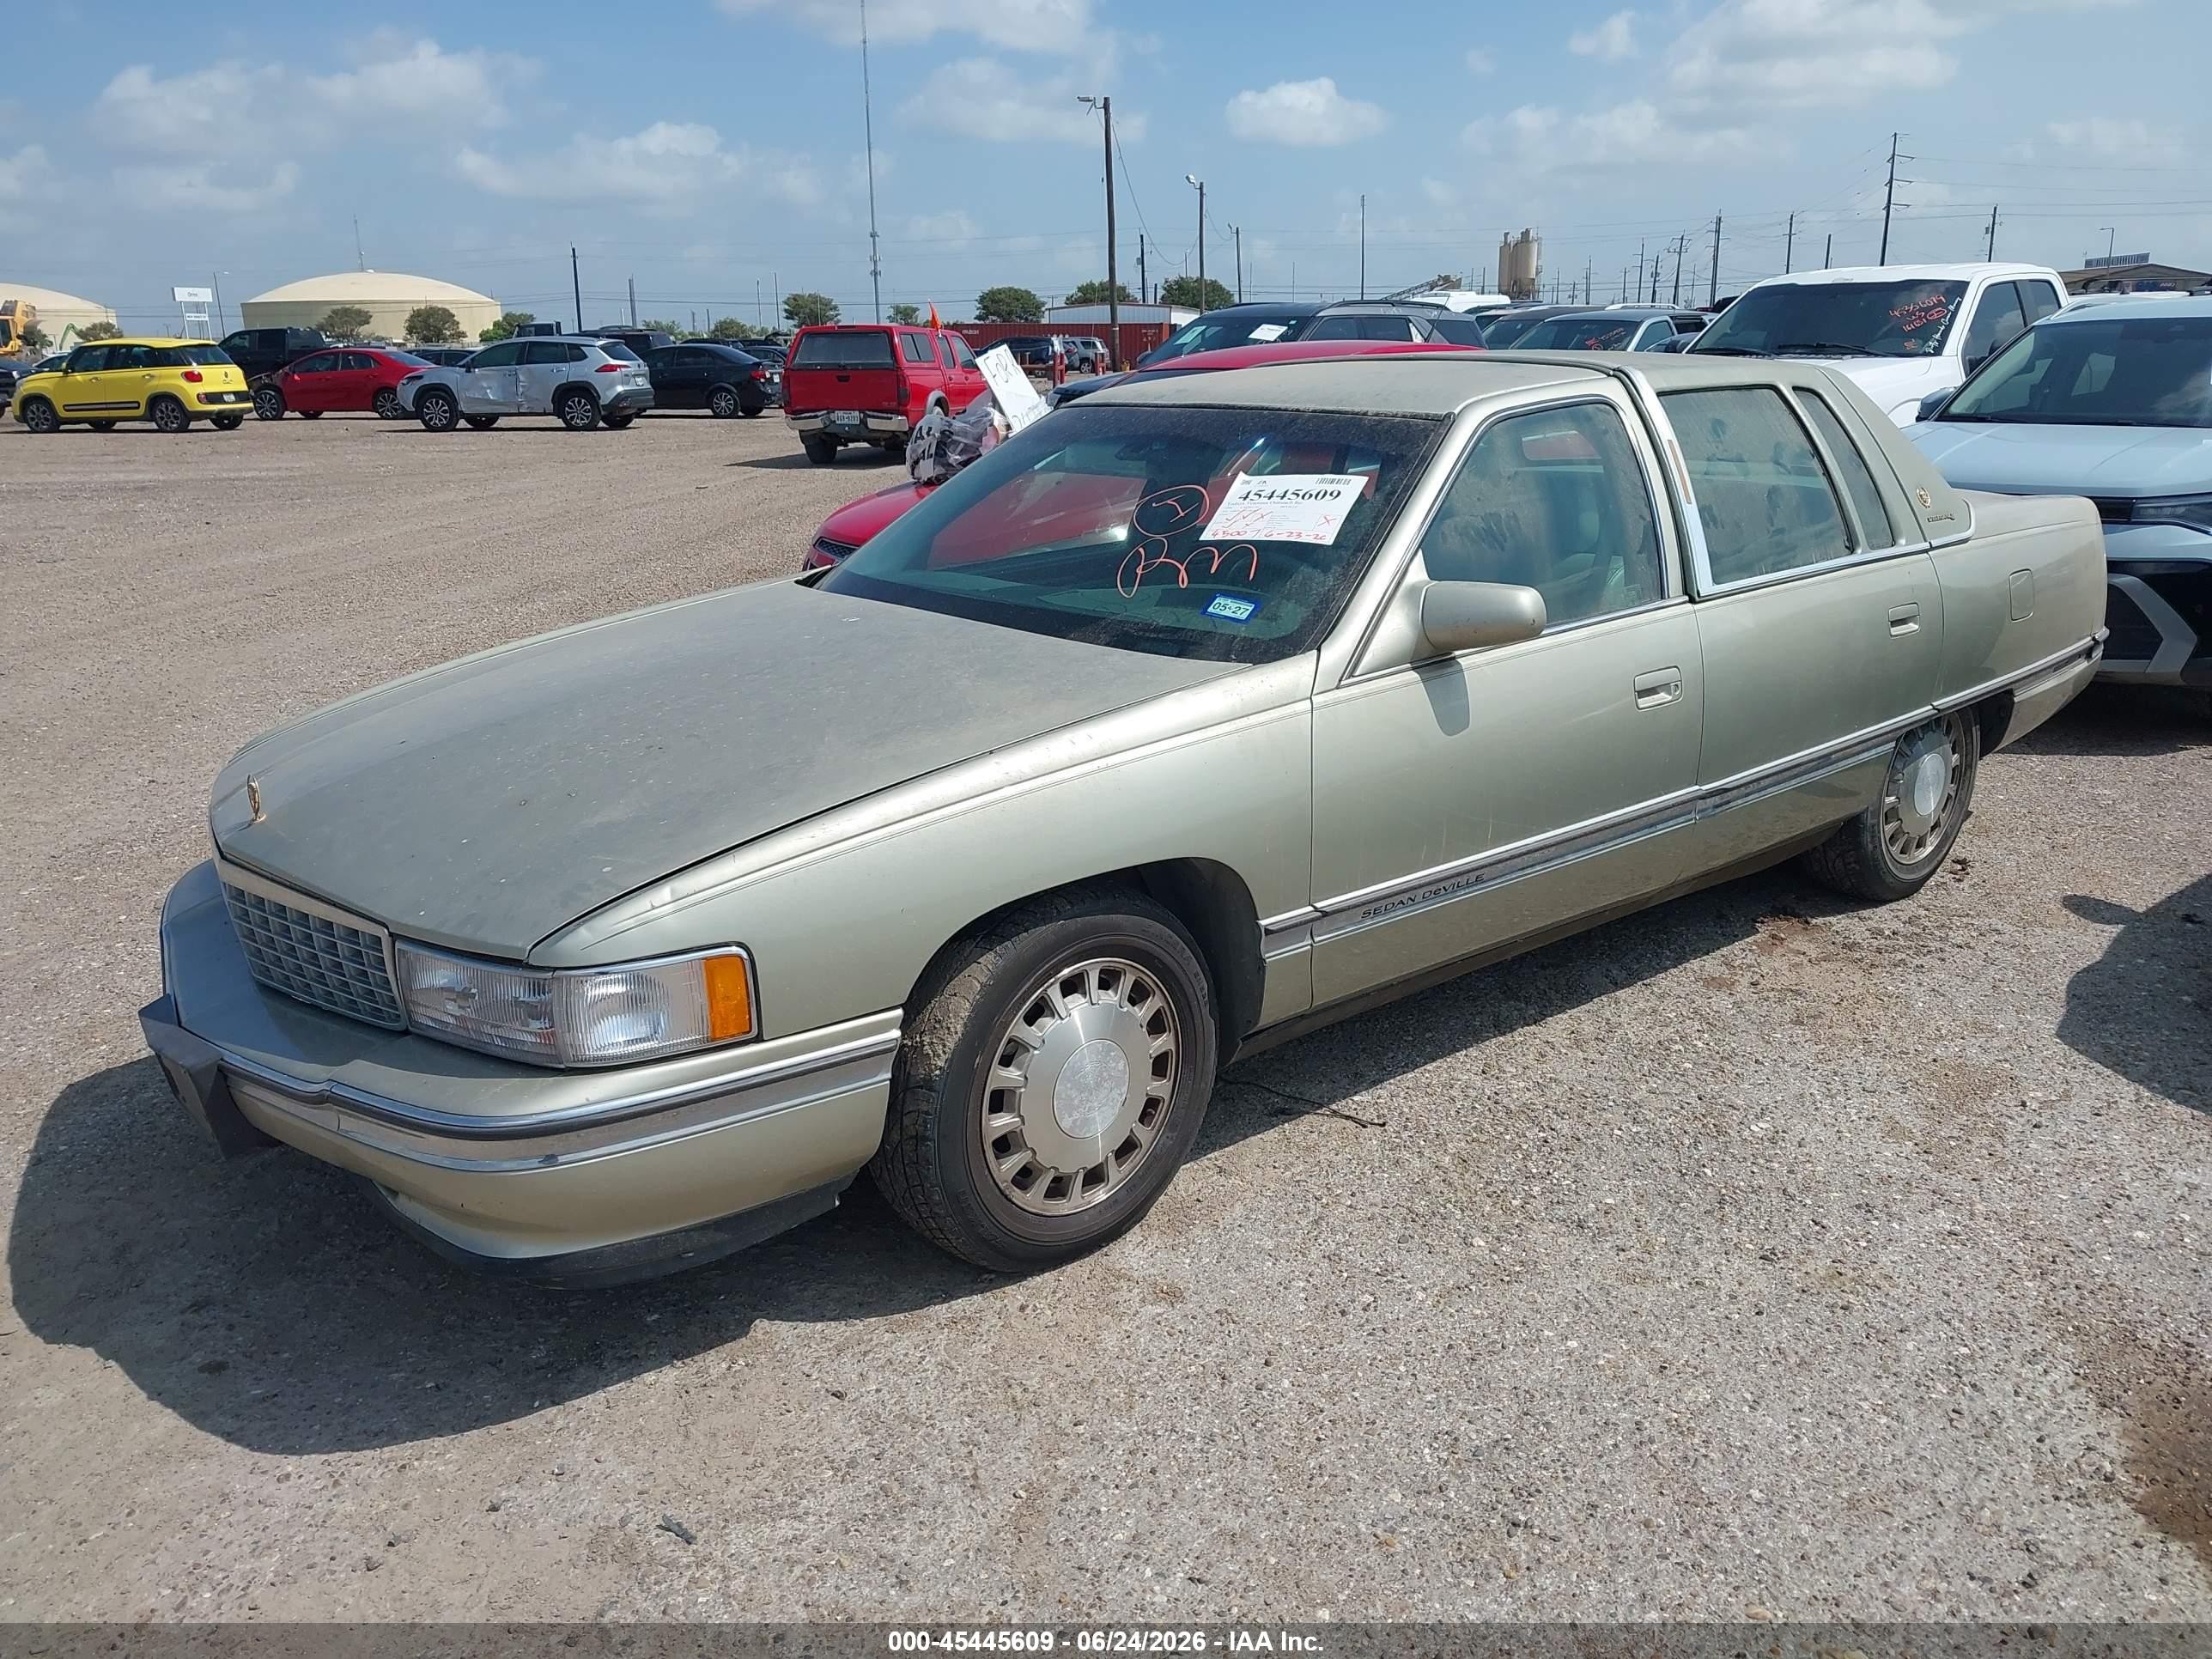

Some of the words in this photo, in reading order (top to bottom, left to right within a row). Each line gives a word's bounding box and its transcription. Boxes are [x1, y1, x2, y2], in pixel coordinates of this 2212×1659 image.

[1238, 488, 1342, 502] 45445609
[1360, 895, 1417, 920] SEDAN
[1421, 872, 1486, 900] DeVILLE
